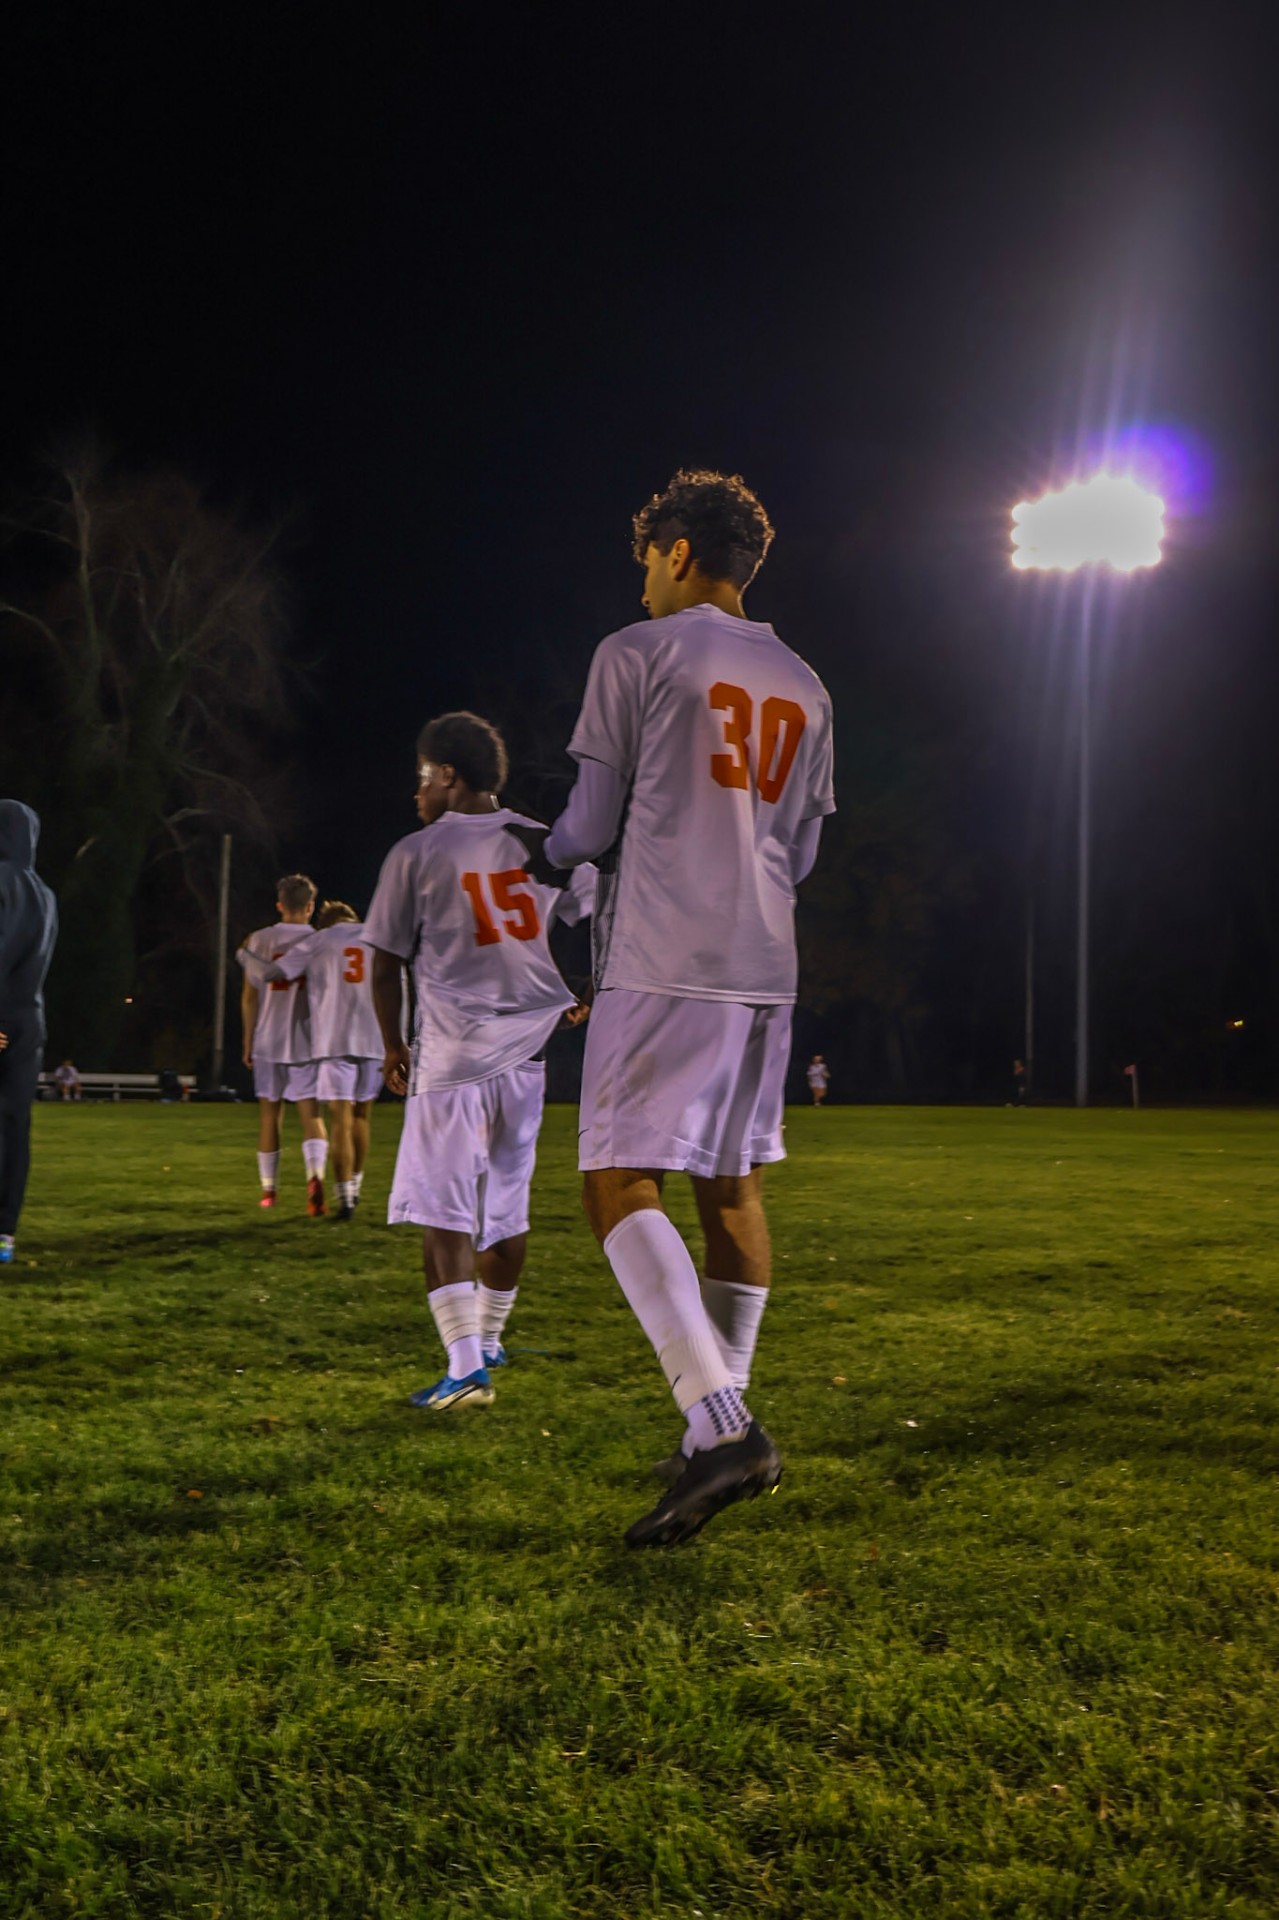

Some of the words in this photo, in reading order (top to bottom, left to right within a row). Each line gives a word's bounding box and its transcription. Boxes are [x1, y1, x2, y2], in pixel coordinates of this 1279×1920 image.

[709, 681, 807, 803] 30
[461, 868, 541, 946] 15
[342, 947, 365, 983] 3
